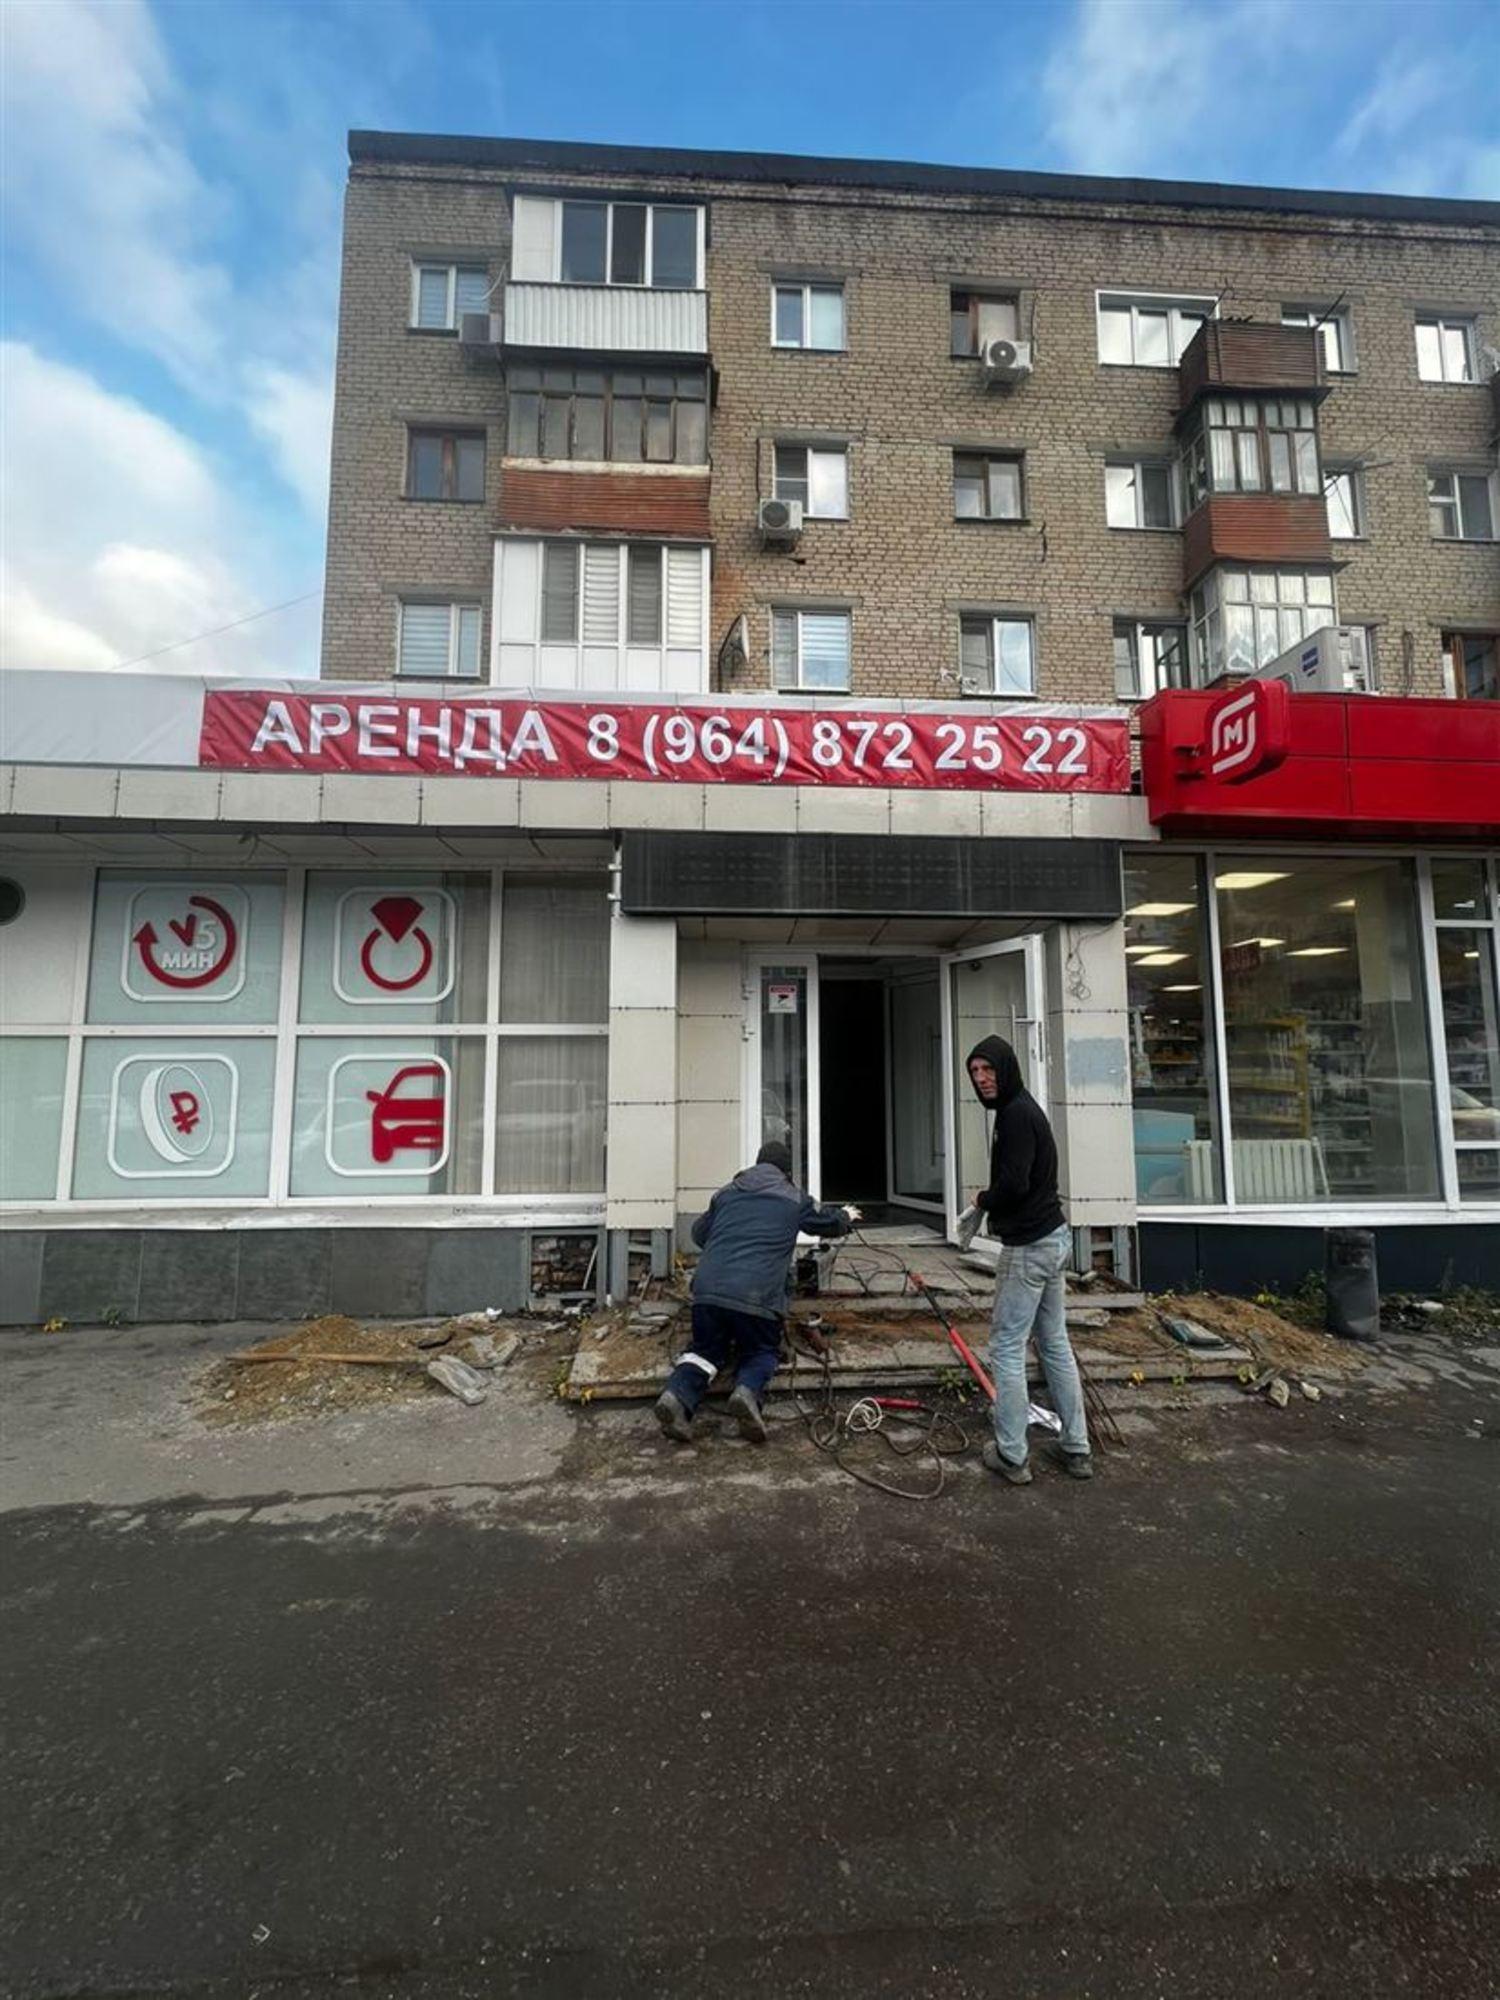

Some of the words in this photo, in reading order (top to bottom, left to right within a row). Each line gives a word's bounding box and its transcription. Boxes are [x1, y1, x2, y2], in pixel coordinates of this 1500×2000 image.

[250, 701, 559, 770] АРЕНДА
[587, 714, 619, 762] 8
[642, 714, 790, 777] (964)
[812, 720, 913, 769] 872
[935, 723, 1002, 770] 25
[1022, 726, 1088, 774] 22
[196, 921, 216, 950] 5
